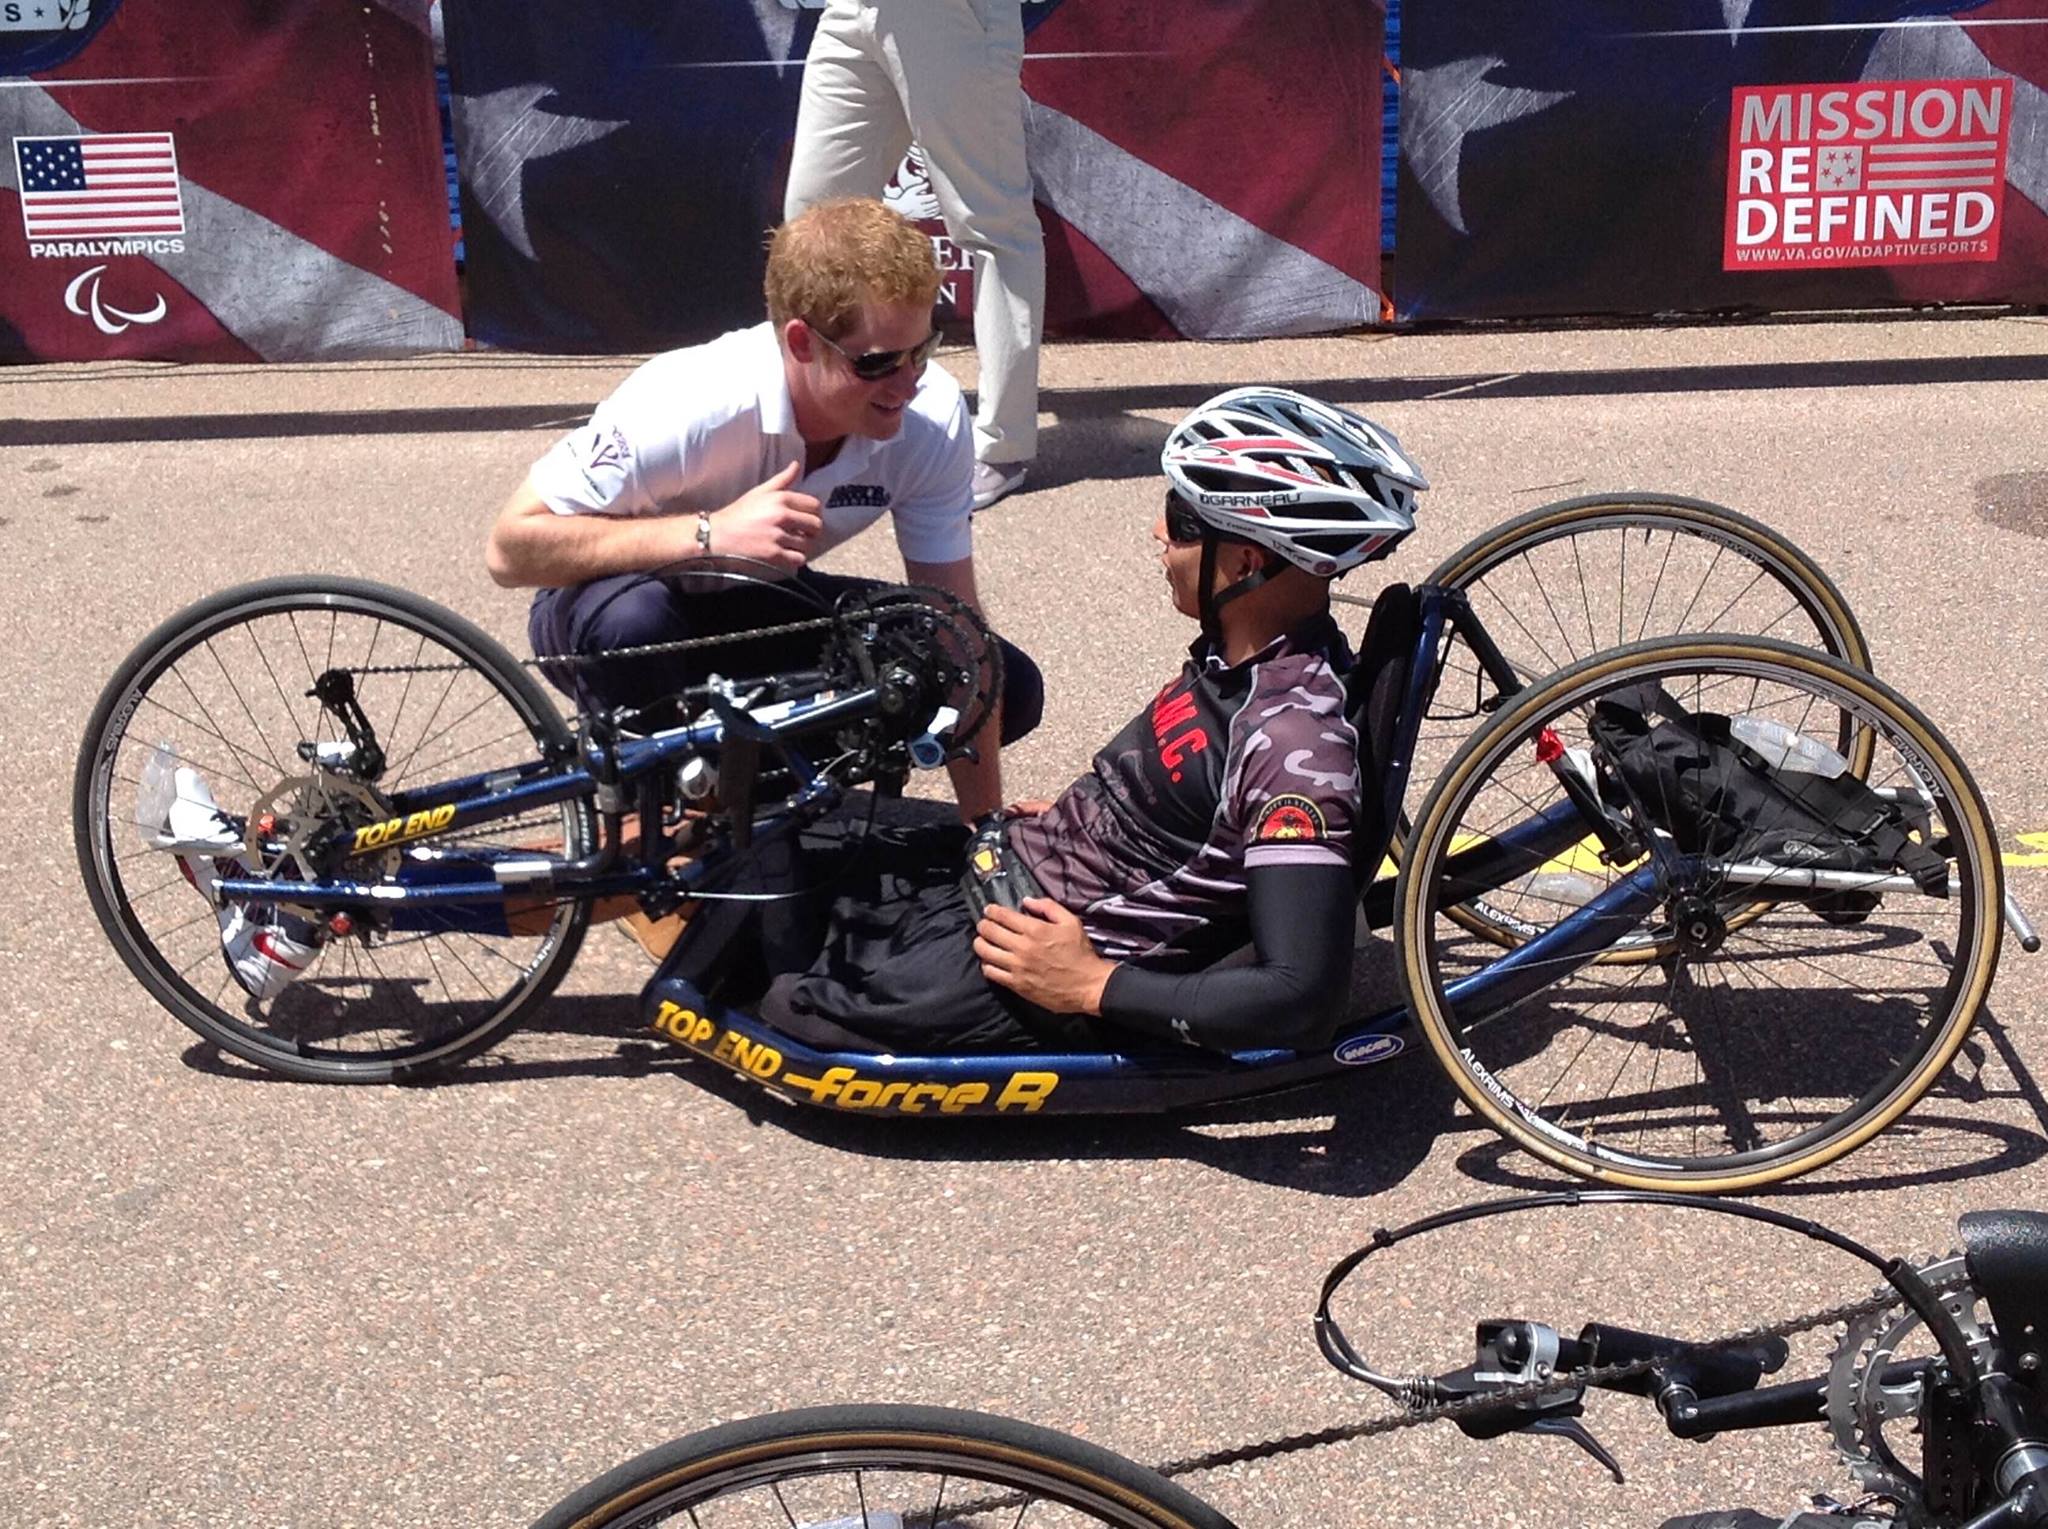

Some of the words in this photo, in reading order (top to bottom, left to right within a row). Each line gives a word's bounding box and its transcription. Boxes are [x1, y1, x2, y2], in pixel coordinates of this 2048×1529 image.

[1740, 87, 2003, 144] MISSION
[1738, 146, 1811, 195] RE
[1736, 191, 1996, 246] DEFINED
[30, 239, 185, 259] PARALYMPICS
[1736, 240, 1989, 263] WWW.VA.GOV/ADAPTIVESPORTS
[1891, 734, 1945, 798] ALEXRIMS
[353, 817, 401, 849] TOP
[404, 804, 456, 835] END
[654, 1000, 716, 1045] TOP
[713, 1030, 783, 1079] END
[995, 1071, 1060, 1112] R
[1460, 1047, 1516, 1109] ALEXRIMS
